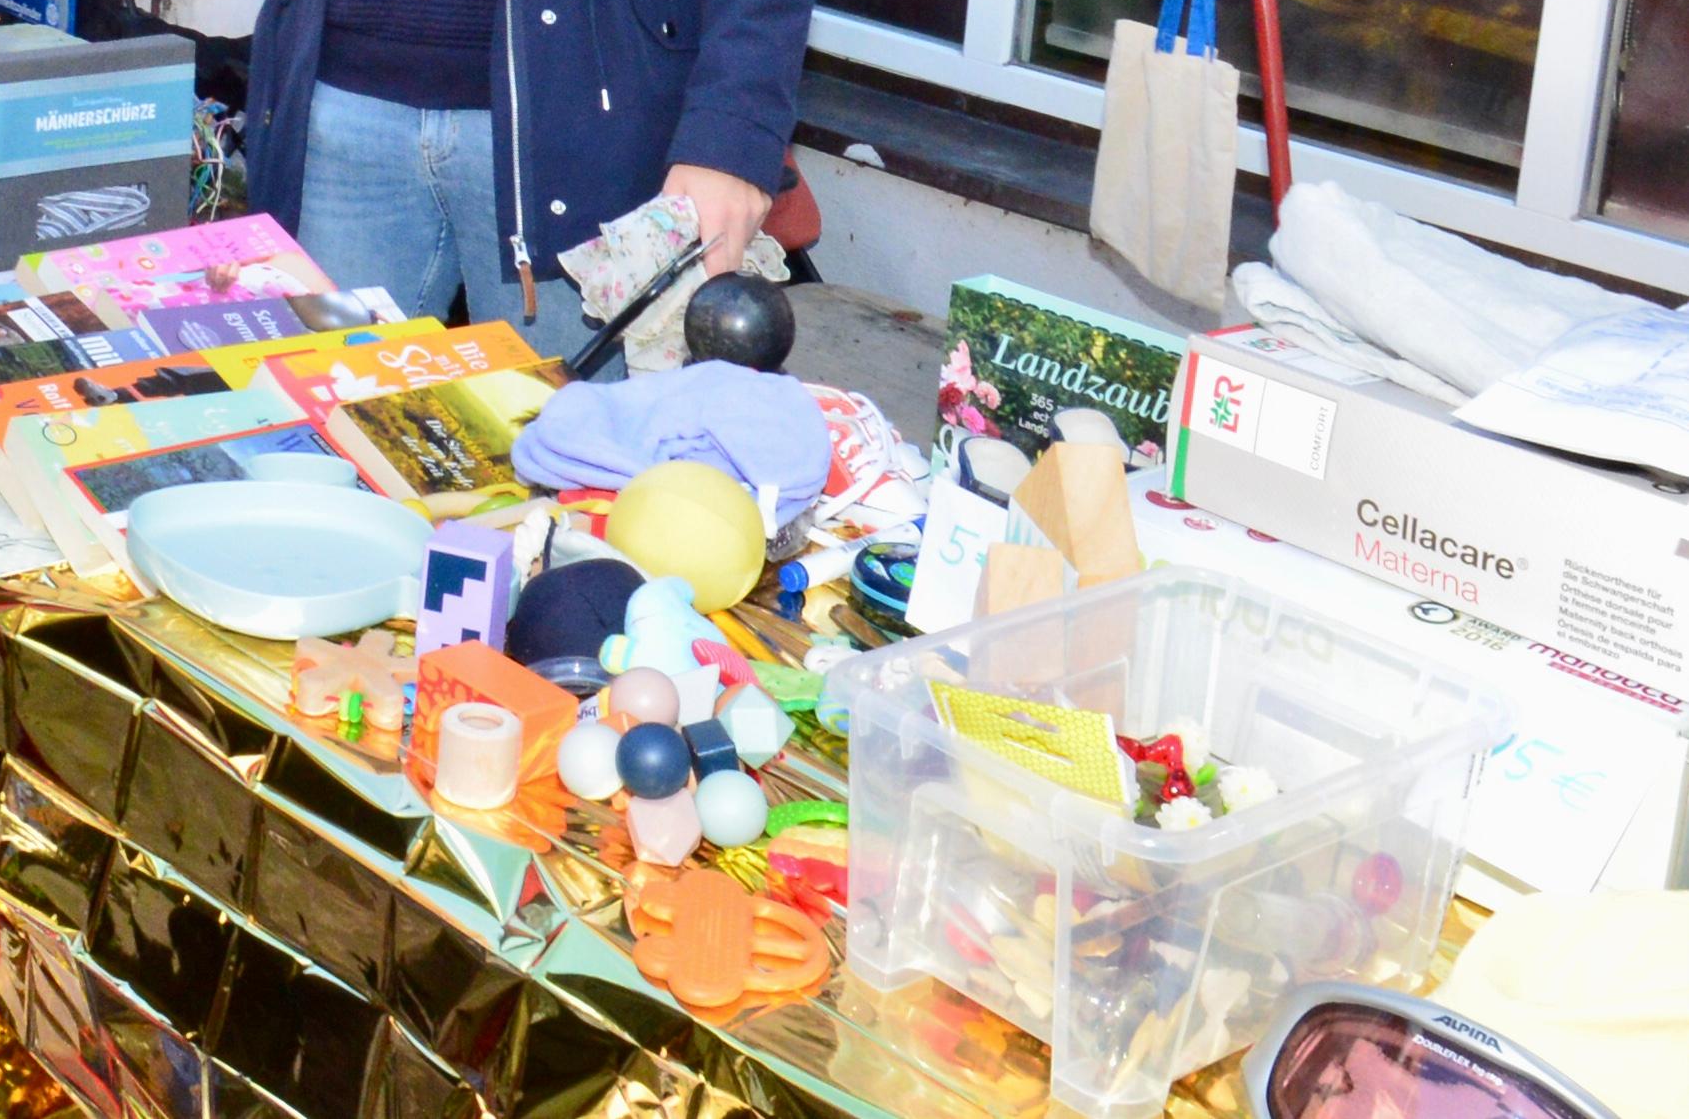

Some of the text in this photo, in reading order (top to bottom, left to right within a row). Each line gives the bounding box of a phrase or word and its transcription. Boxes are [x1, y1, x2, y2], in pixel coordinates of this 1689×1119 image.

[35, 102, 157, 132] MÄNNERSCHÜRZE
[77, 335, 124, 368] Mil
[451, 340, 489, 370] Die
[37, 383, 73, 410] Rolf
[1029, 393, 1054, 411] 365
[1310, 406, 1329, 471] COMFORT
[1354, 532, 1479, 605] Materna
[1564, 558, 1662, 601] Rückenorthese für
[1562, 570, 1675, 616] die Schwangerschaft
[1559, 605, 1683, 659] Maternity back orthosis
[1571, 597, 1608, 617] femme
[1610, 614, 1656, 635] enceinte
[1604, 599, 1645, 620] dorsale
[1647, 615, 1673, 630] pour
[1568, 635, 1620, 660] embarazo
[1597, 634, 1611, 645] de
[1613, 641, 1655, 662] espalda
[1657, 657, 1682, 673] para
[1432, 1014, 1503, 1054] ALPINA
